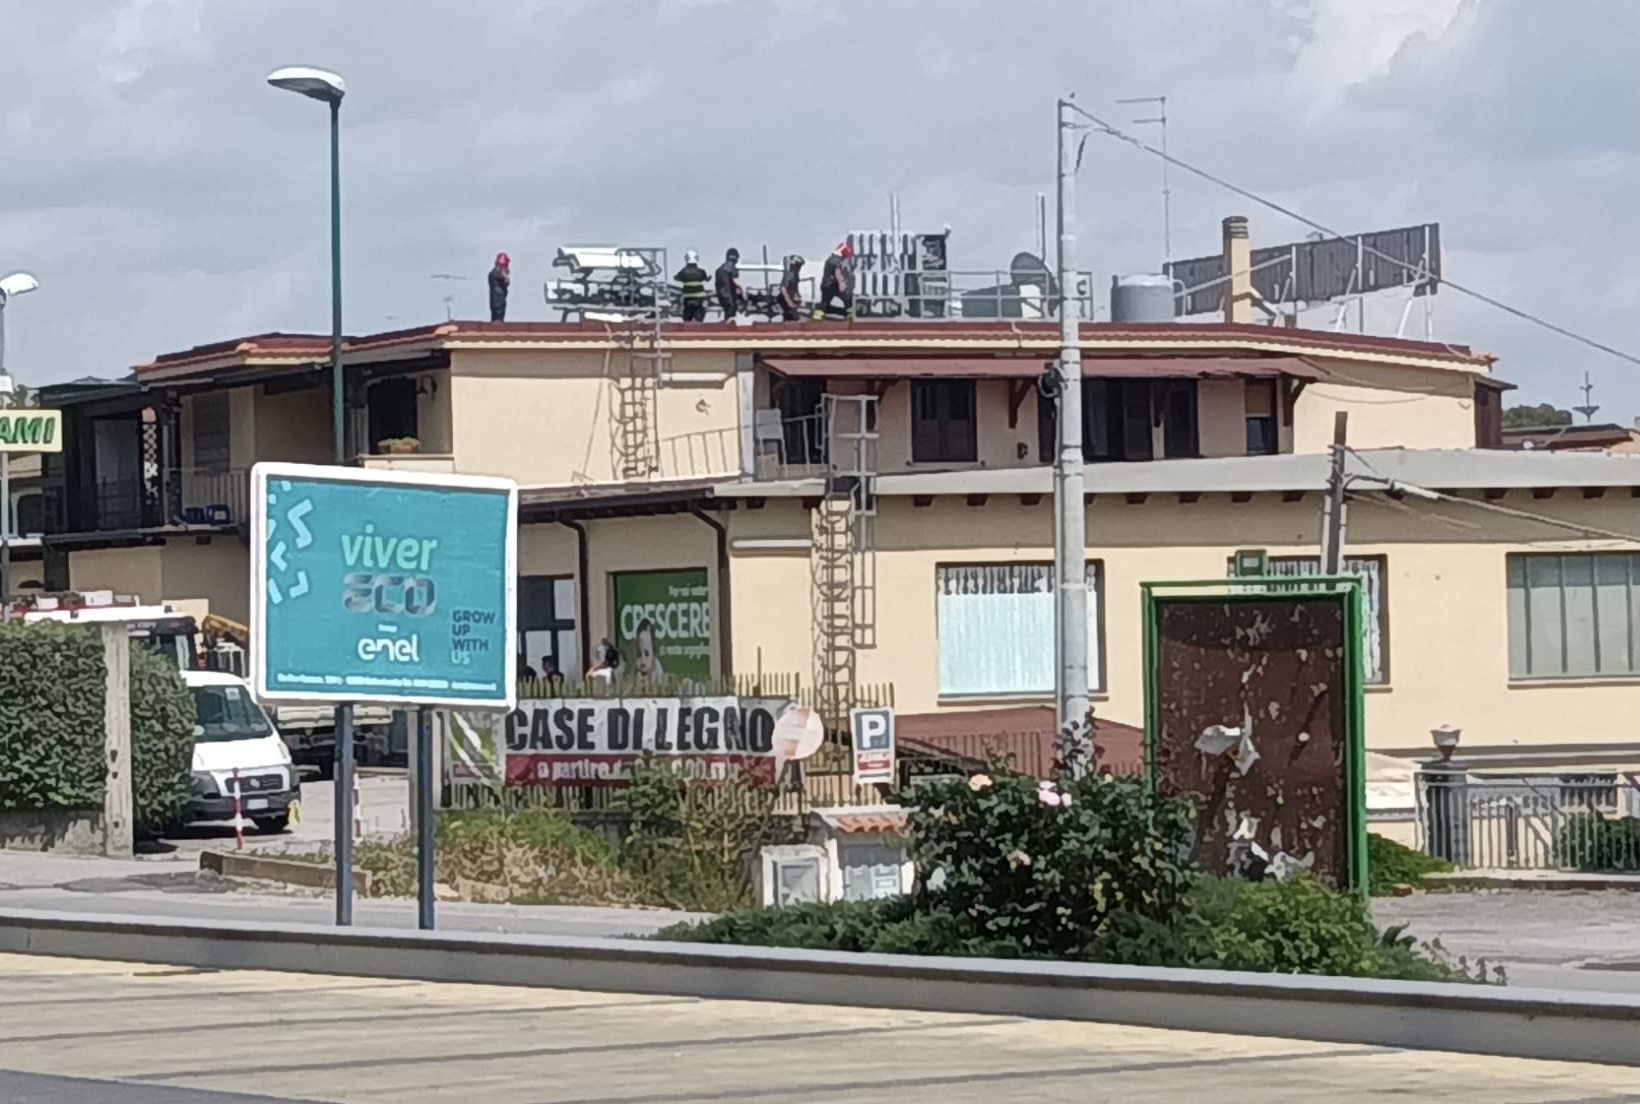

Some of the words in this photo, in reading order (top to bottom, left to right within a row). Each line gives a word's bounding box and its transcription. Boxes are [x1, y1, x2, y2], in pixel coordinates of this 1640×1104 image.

[340, 524, 438, 570] viver
[343, 572, 437, 616] ECO
[452, 609, 496, 624] GROW
[452, 624, 471, 638] UP
[357, 633, 420, 663] enel
[450, 652, 471, 665] US
[452, 638, 490, 652] WITH
[505, 707, 595, 750] CASE
[607, 707, 645, 750] DI
[655, 706, 775, 753] LEGNO
[861, 714, 886, 748] P
